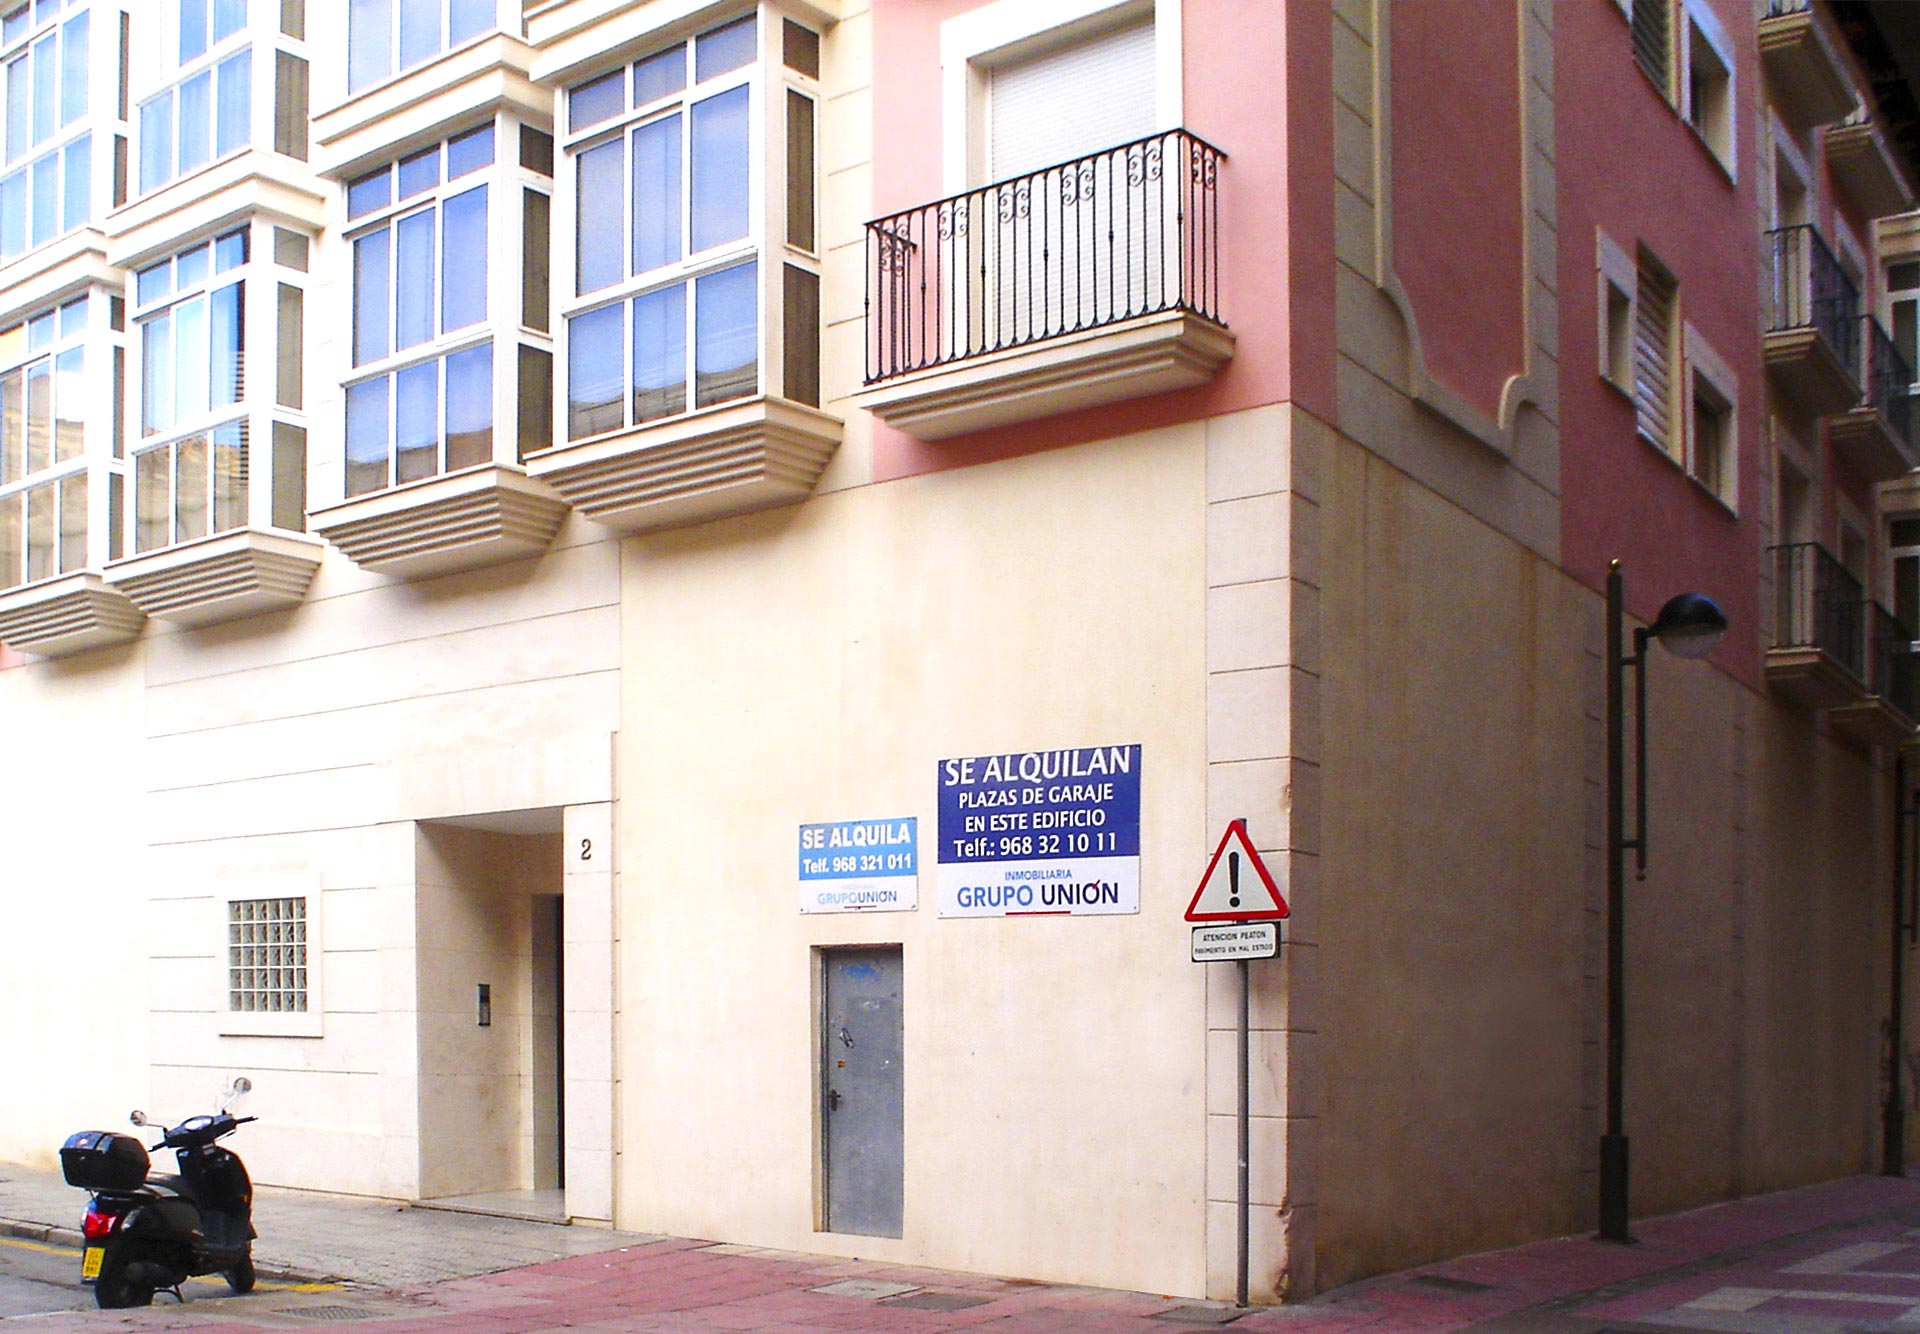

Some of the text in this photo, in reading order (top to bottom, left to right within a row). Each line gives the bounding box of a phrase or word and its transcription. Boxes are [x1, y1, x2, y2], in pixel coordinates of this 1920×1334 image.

[945, 746, 1131, 787] SE ALQUILAN
[959, 783, 1114, 809] PLAZAS DE GARAJE
[965, 809, 1106, 833] EN ESTE EDIFICIO
[581, 838, 592, 860] 2
[802, 823, 912, 850] SE ALQUILA
[953, 832, 1116, 858] Telf.: 968 32 10 11
[803, 853, 911, 874] Telf. 968 321 011
[1005, 869, 1073, 881] INMOBILIARIA
[957, 880, 1118, 908] GRUPO UNIÓN
